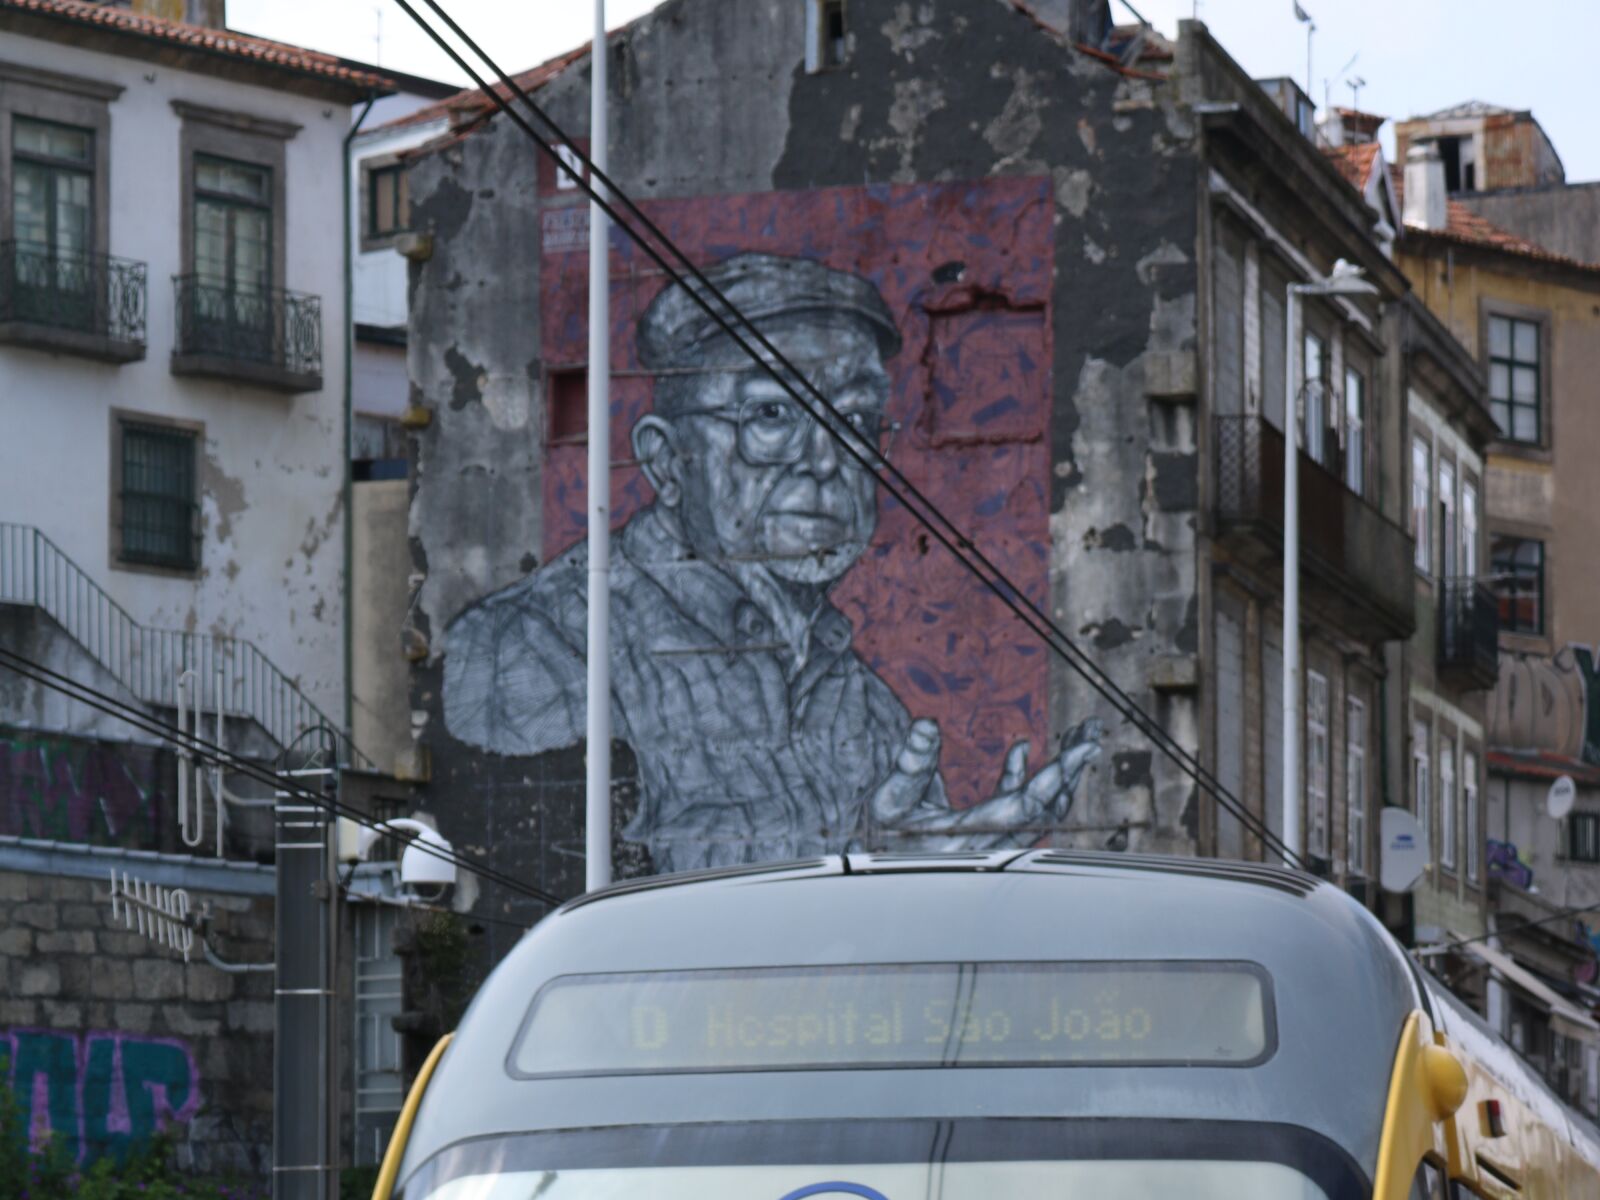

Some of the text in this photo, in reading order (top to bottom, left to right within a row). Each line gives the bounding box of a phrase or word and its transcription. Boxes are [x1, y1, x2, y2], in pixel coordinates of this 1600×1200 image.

[631, 1005, 668, 1049] D
[706, 1000, 903, 1047] Hospital
[1034, 989, 1152, 1042] João
